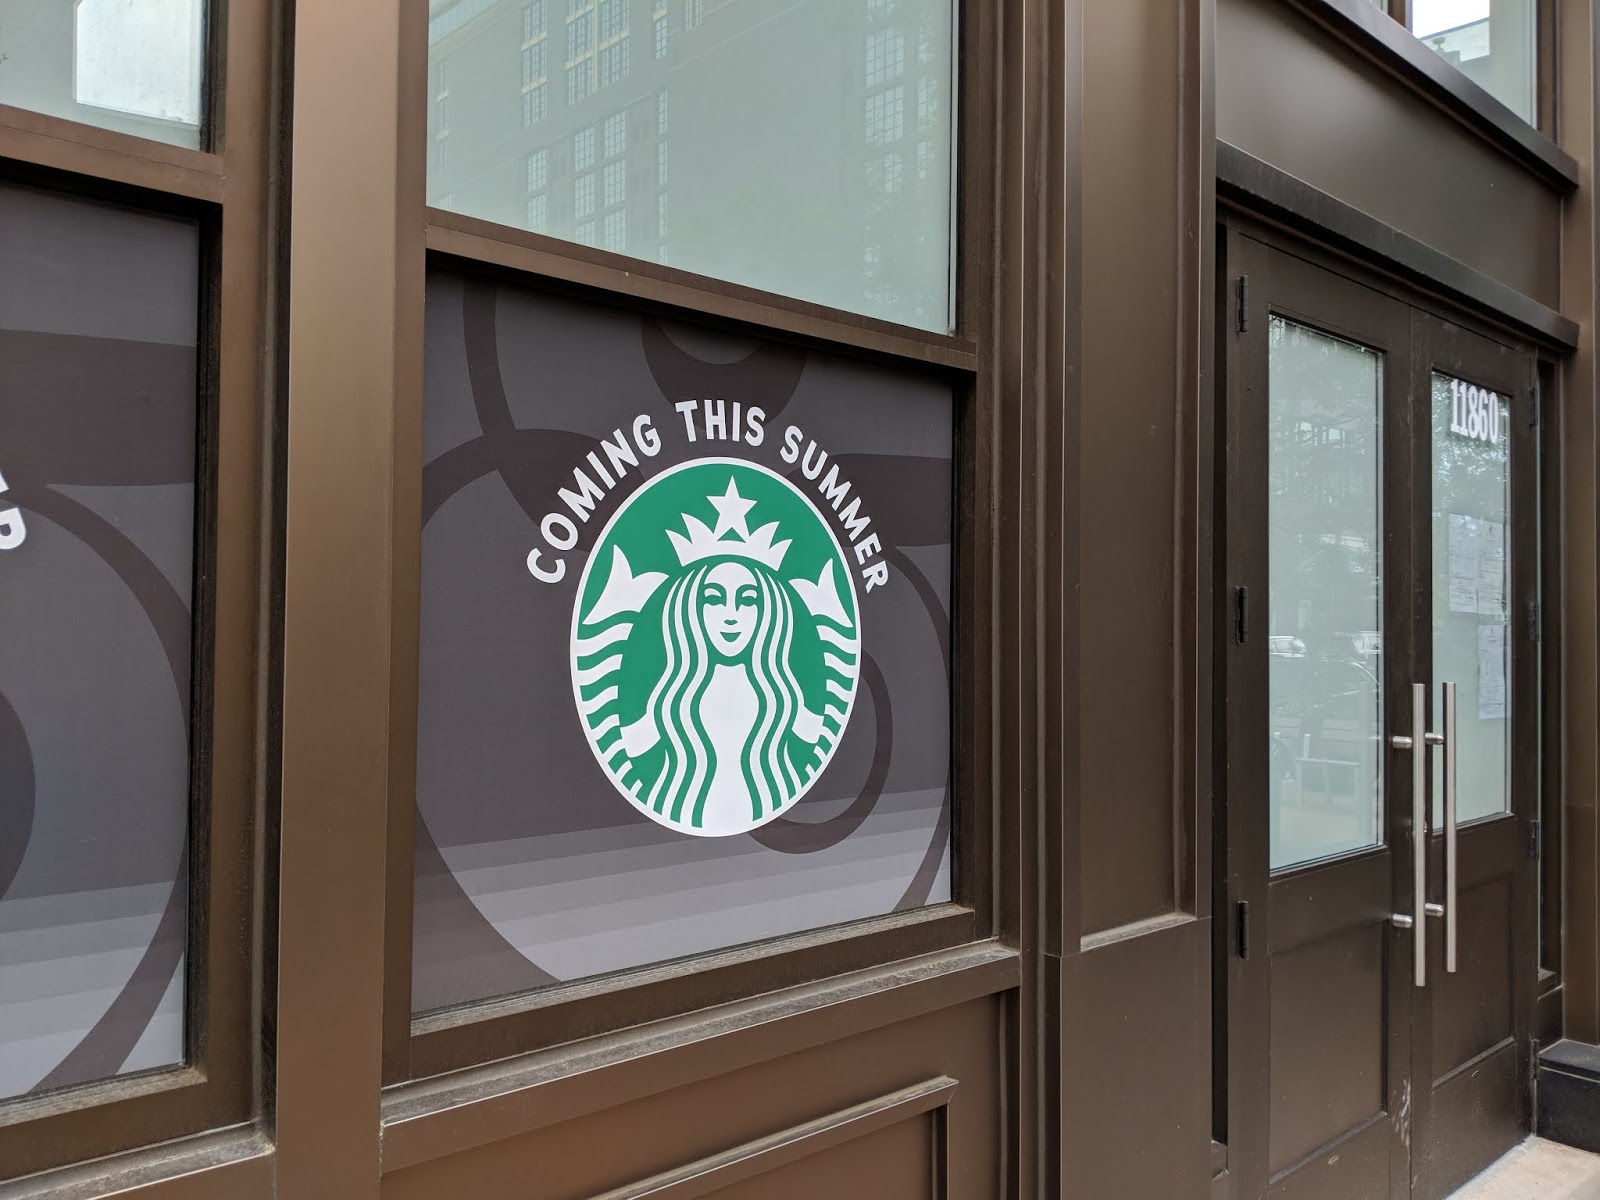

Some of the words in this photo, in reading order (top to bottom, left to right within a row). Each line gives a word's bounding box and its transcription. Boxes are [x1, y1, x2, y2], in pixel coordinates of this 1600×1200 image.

[1450, 379, 1499, 444] 11860
[526, 414, 662, 584] COMING
[675, 399, 766, 447] THIS
[779, 425, 890, 594] SUMMER
